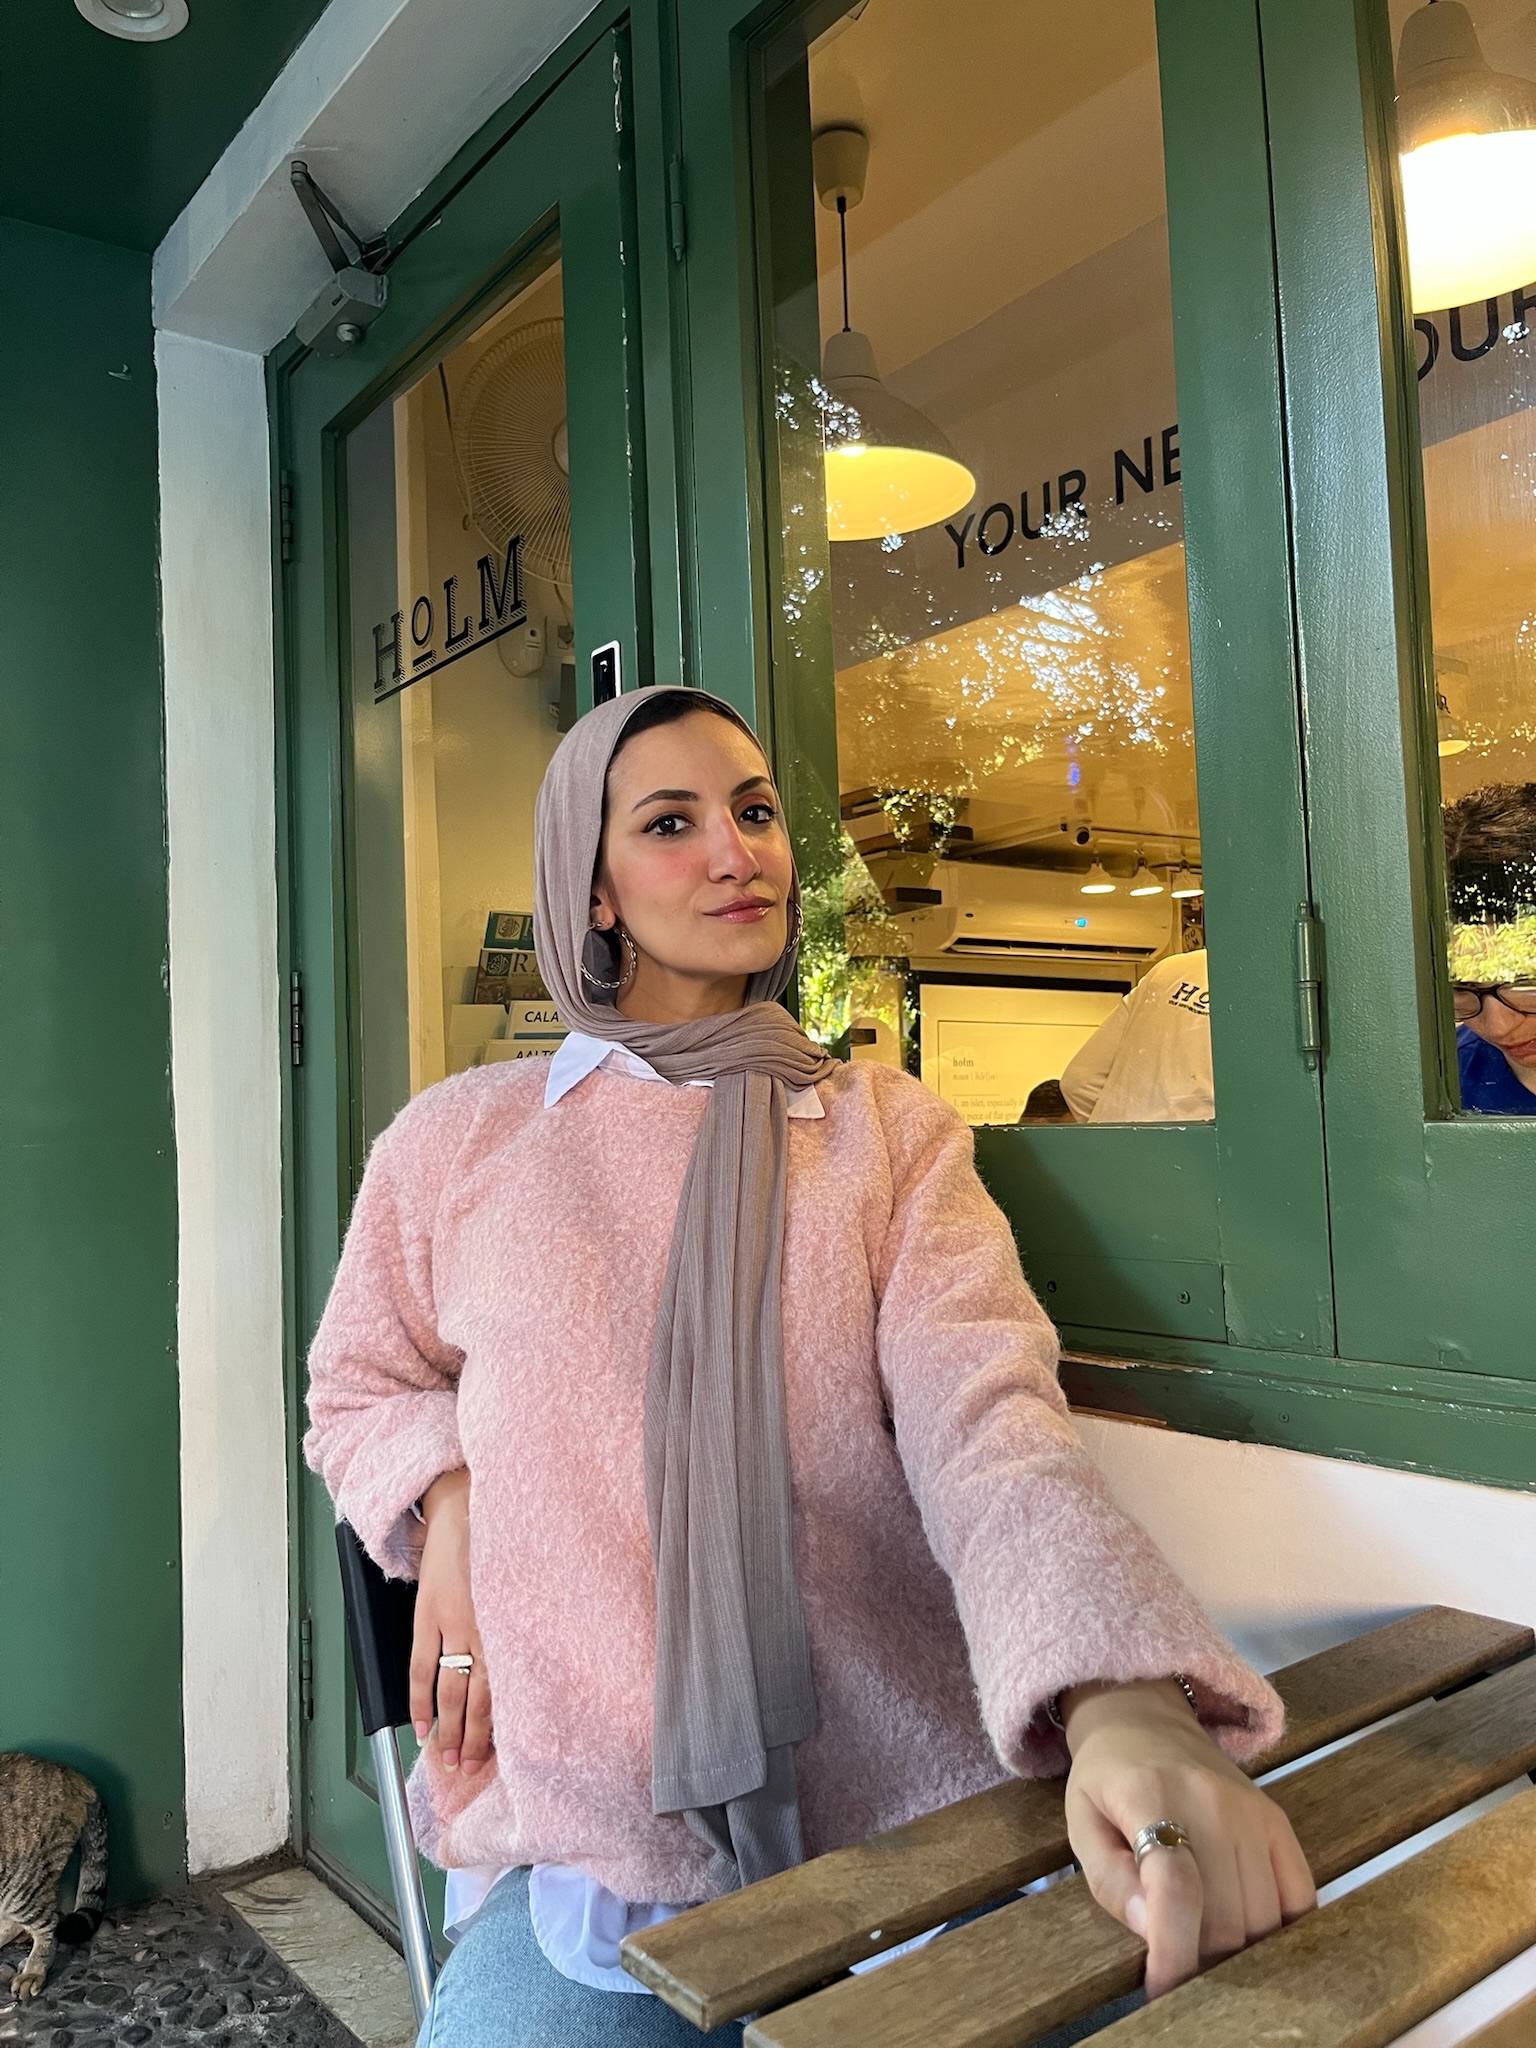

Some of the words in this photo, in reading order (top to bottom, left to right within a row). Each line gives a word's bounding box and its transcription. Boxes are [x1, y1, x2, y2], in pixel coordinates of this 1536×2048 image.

[944, 469, 1088, 569] YOUR
[1114, 424, 1181, 505] NE
[372, 534, 527, 694] HOLM
[952, 1057, 974, 1067] holm
